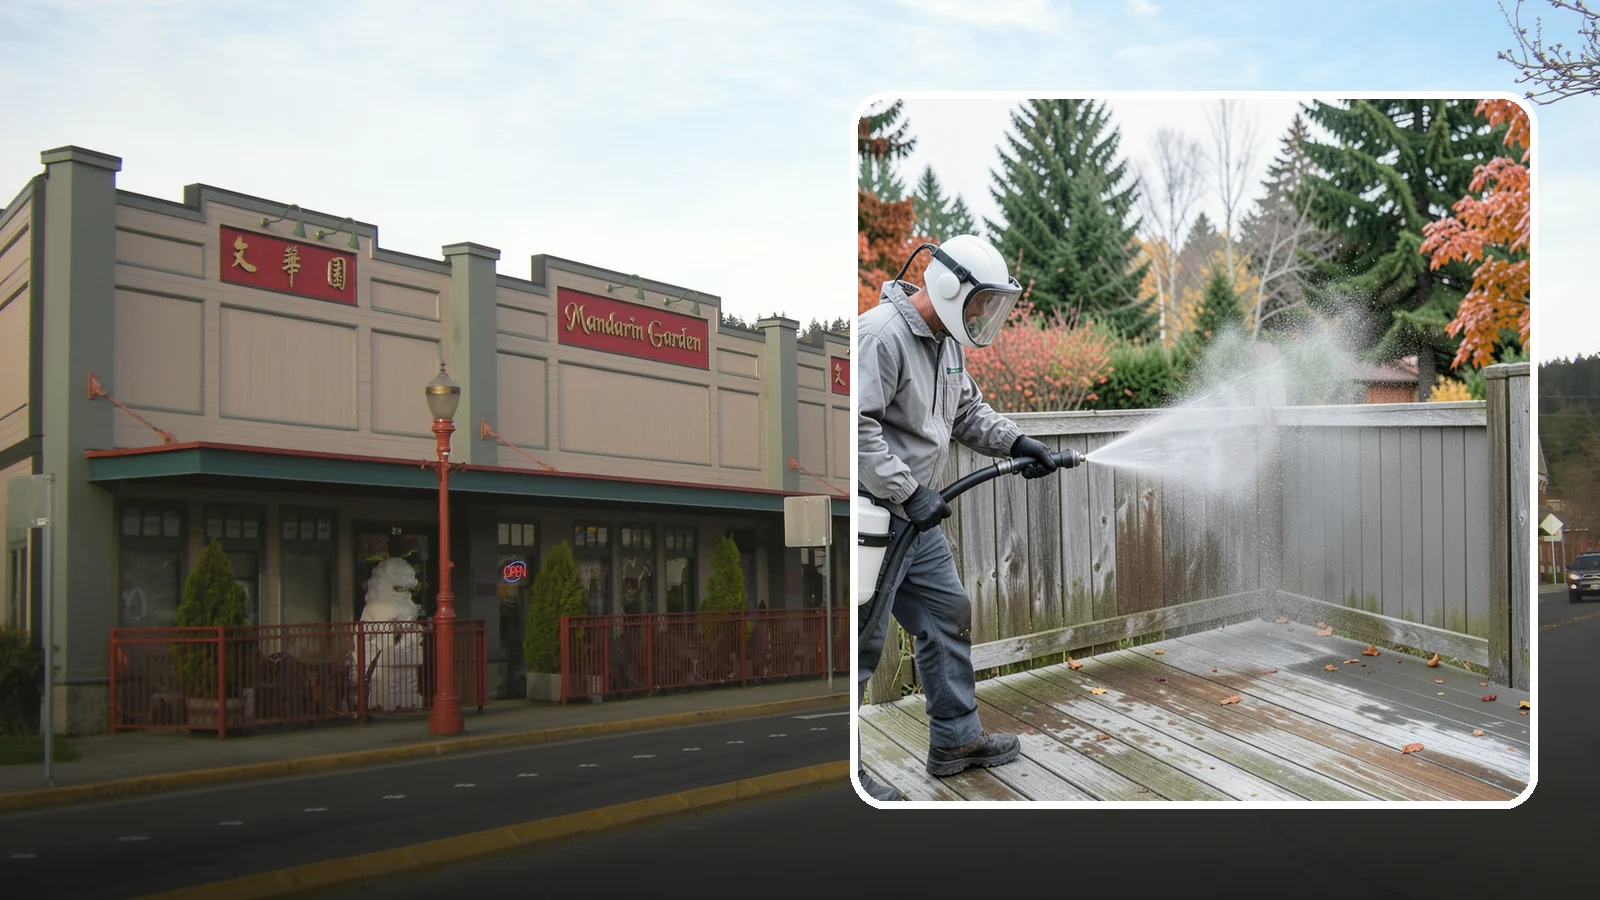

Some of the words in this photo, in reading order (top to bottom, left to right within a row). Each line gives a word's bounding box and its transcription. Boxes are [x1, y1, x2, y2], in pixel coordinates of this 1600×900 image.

[231, 235, 346, 291] 文華園
[564, 302, 644, 341] Mandarin
[648, 320, 701, 352] Garden
[503, 565, 527, 578] OPEN
